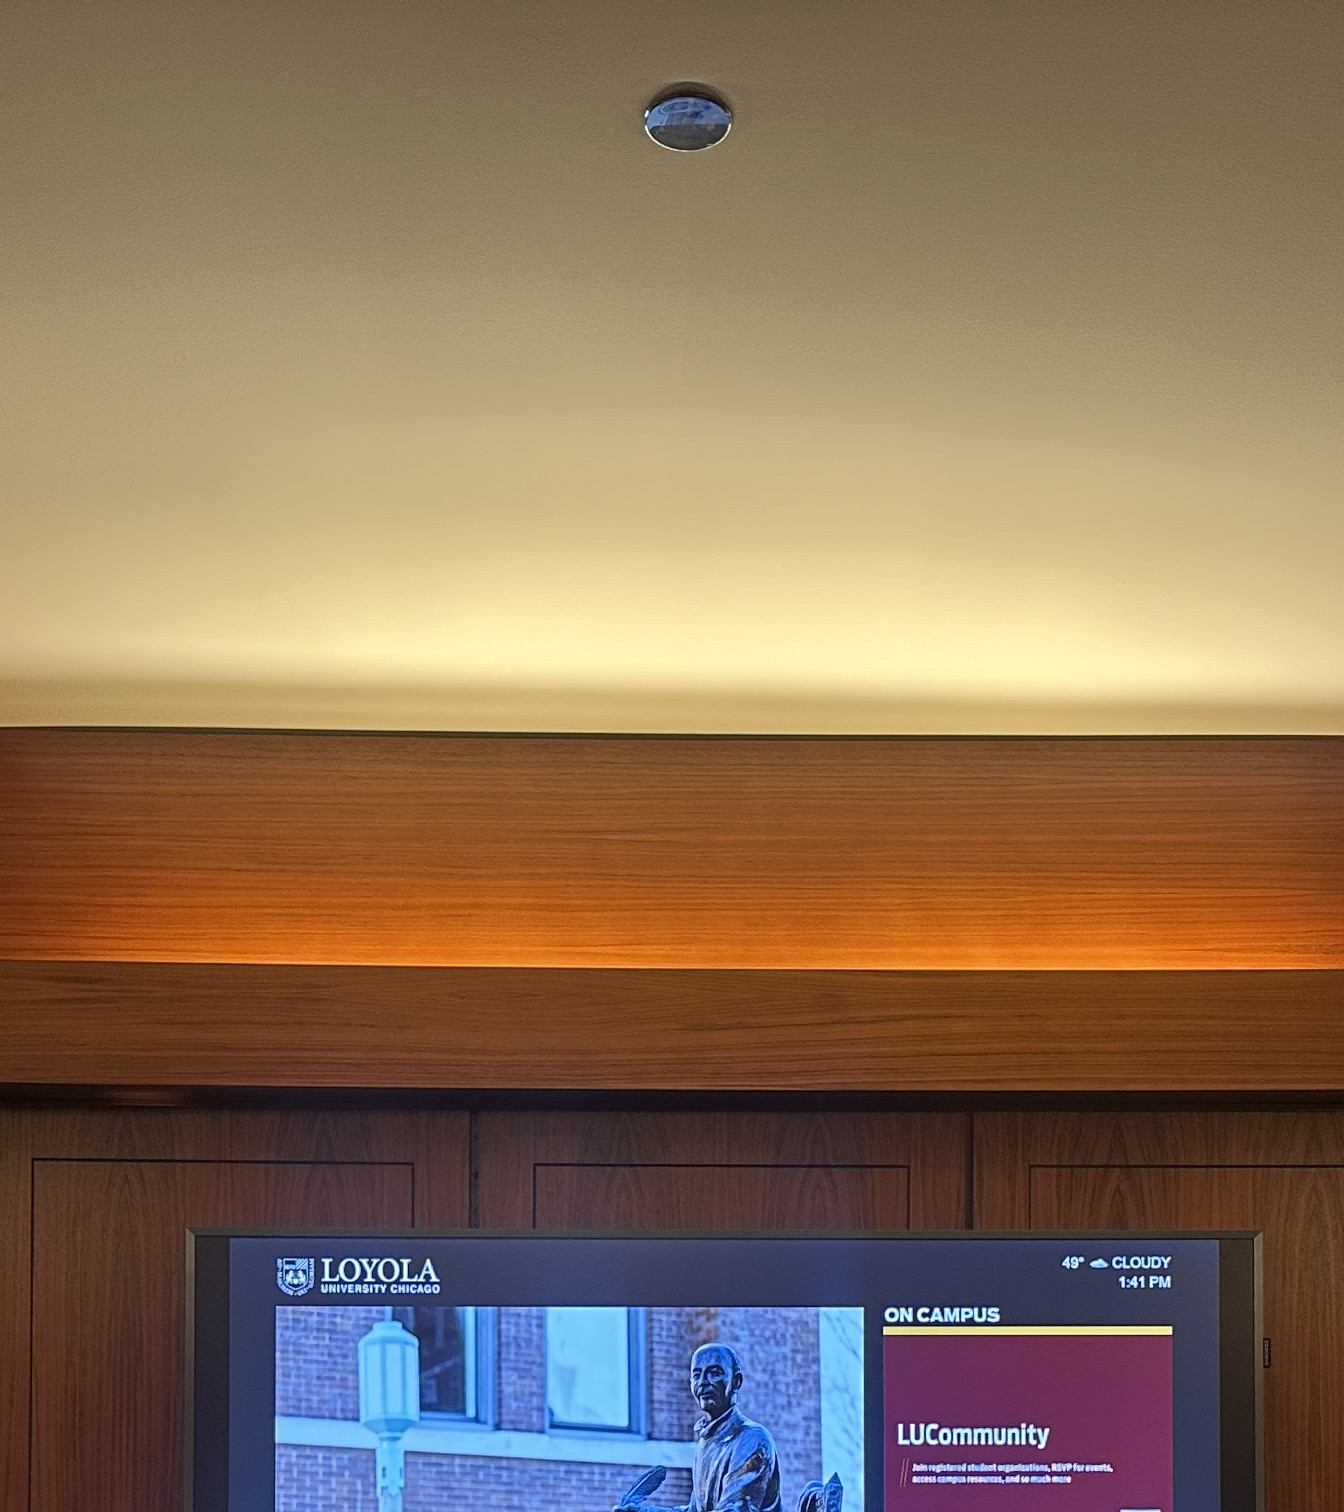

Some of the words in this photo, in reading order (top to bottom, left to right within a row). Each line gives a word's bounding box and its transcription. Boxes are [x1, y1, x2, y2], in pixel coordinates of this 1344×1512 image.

[1111, 1256, 1172, 1269] CLOUDY
[321, 1258, 441, 1282] LOYOLA
[1118, 1275, 1145, 1288] 1:41
[1149, 1275, 1172, 1288] PM
[320, 1284, 387, 1294] UNIVERSITY
[390, 1284, 441, 1294] CHICAGO
[884, 1307, 913, 1322] ON
[916, 1307, 1000, 1323] CAMPUS
[897, 1423, 1050, 1449] LUCommunity
[912, 1462, 928, 1473] Join
[928, 1462, 967, 1474] registered
[967, 1463, 997, 1473] student
[1051, 1462, 1072, 1473] RSVP
[1073, 1462, 1085, 1473] for
[912, 1475, 937, 1484] access
[937, 1475, 966, 1485] campus
[1005, 1474, 1020, 1484] and
[1020, 1475, 1030, 1484] so
[1030, 1474, 1051, 1484] much
[1051, 1475, 1072, 1484] more
